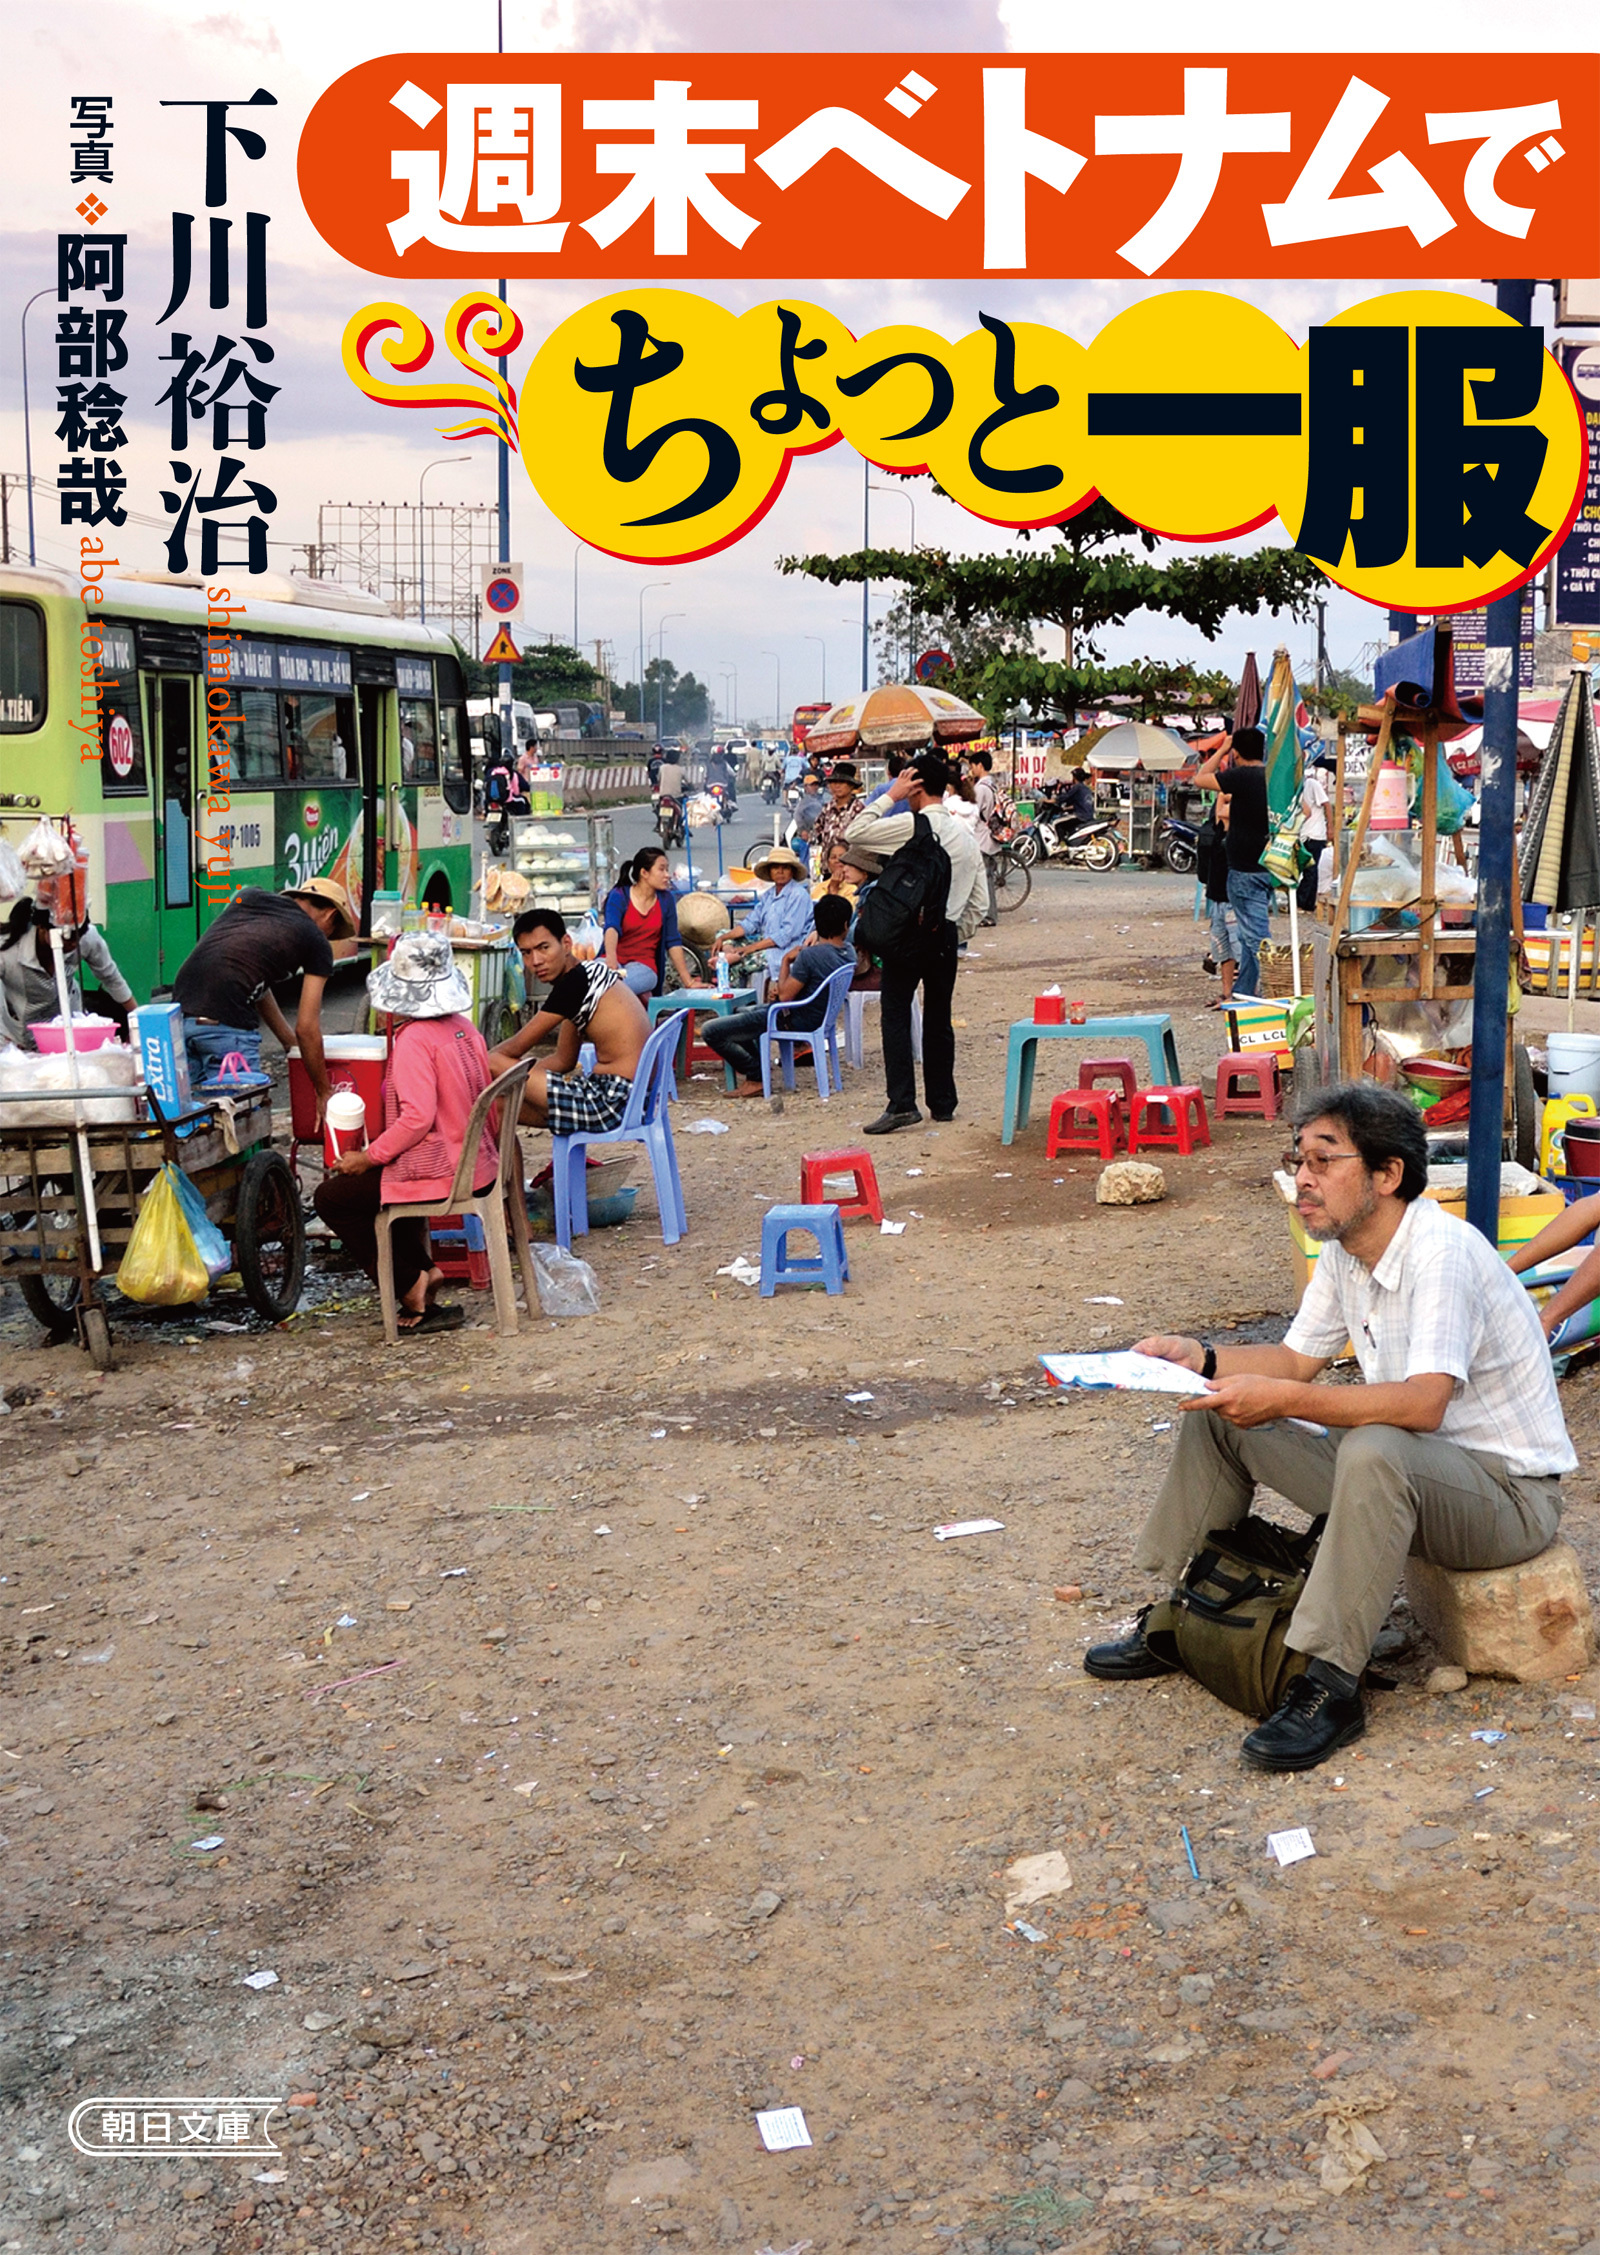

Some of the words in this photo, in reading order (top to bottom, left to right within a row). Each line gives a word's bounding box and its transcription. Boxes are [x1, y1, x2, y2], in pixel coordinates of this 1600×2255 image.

[492, 567, 512, 575] ZONE
[110, 727, 132, 765] 602
[146, 1035, 168, 1102] Extra
